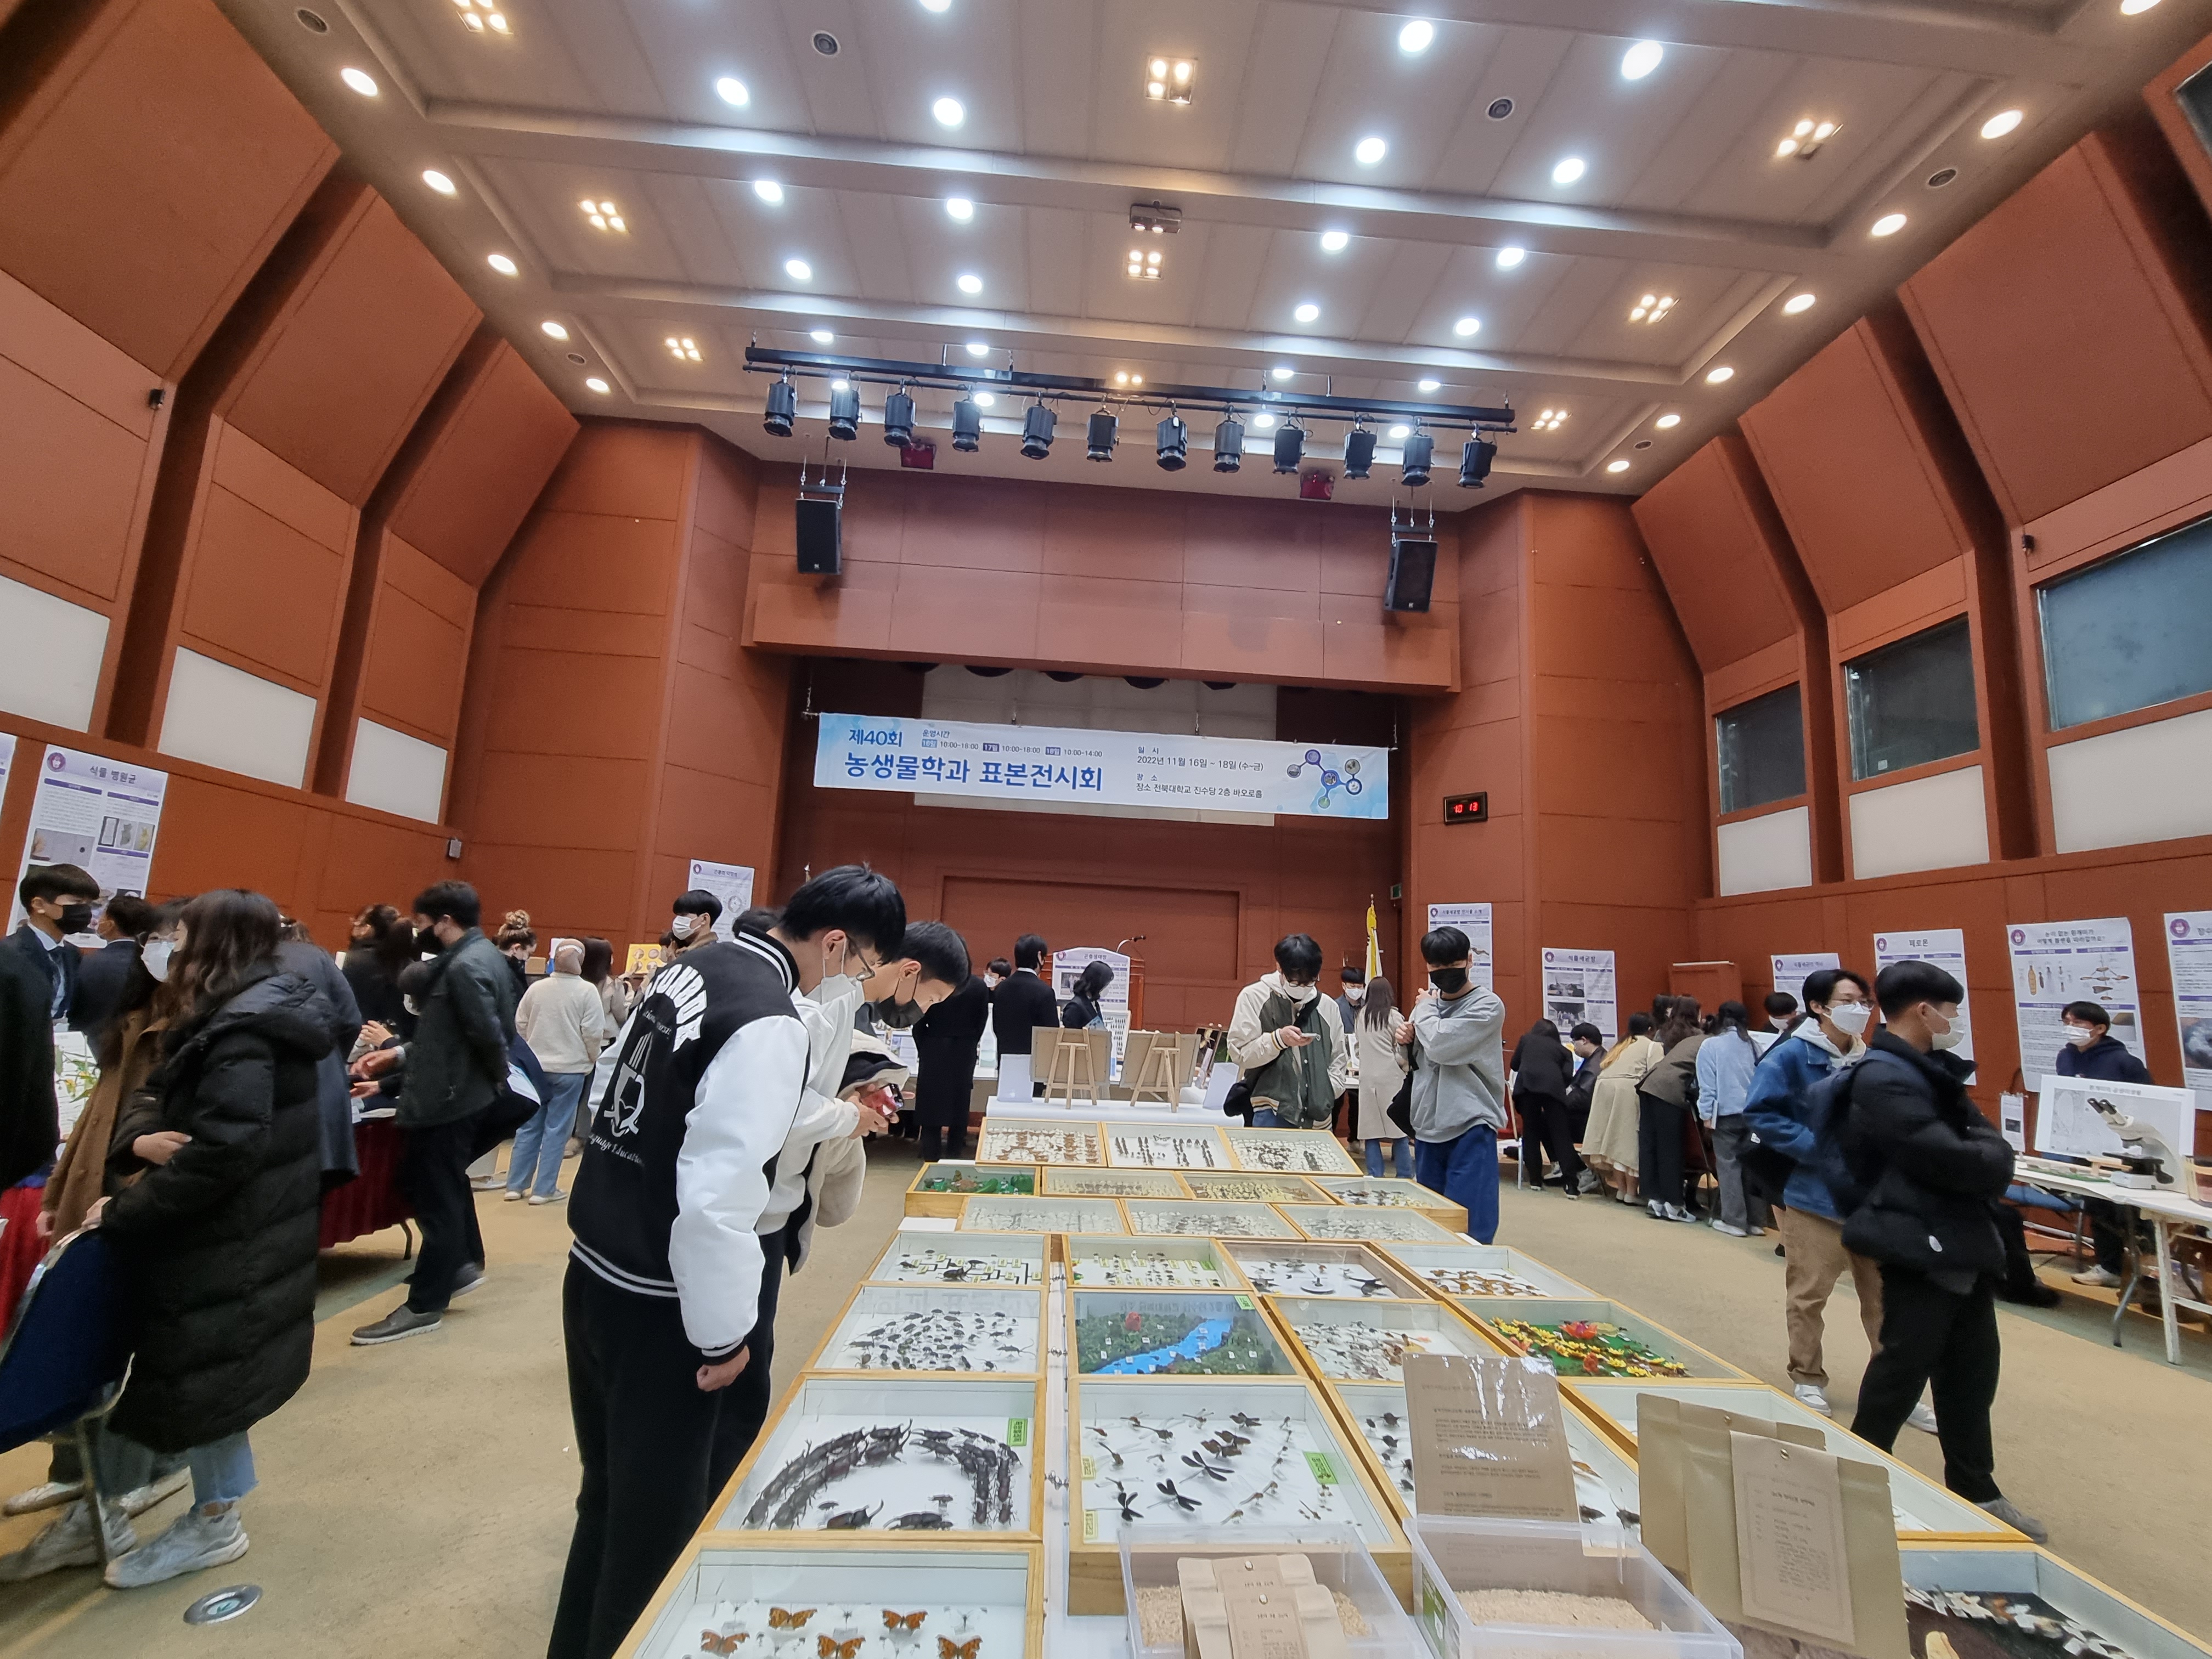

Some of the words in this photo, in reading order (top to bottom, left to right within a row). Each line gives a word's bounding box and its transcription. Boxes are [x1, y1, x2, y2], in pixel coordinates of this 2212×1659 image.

[848, 729, 902, 747] 제40회
[922, 729, 950, 738] 운영시간
[940, 741, 979, 750] 10:00-18:00
[1002, 744, 1041, 754] 10:00-18:00
[1064, 748, 1103, 757] 10:00-14:00
[1137, 755, 1164, 765] 2022년
[1167, 757, 1186, 767] 11월
[1189, 758, 1207, 768] 16일
[1218, 760, 1236, 770] 18일
[1239, 761, 1263, 771] (수~금)
[89, 765, 107, 778] 식물
[844, 752, 971, 783] 농생물학과
[979, 761, 1102, 791] 표본전시회
[1136, 783, 1152, 792] 장소
[1154, 783, 1191, 794] 전북대학교
[1194, 785, 1216, 795] 진수당
[1218, 788, 1231, 797] 2층
[1233, 788, 1262, 798] 바오로홀
[1909, 939, 1928, 947] 페로몬
